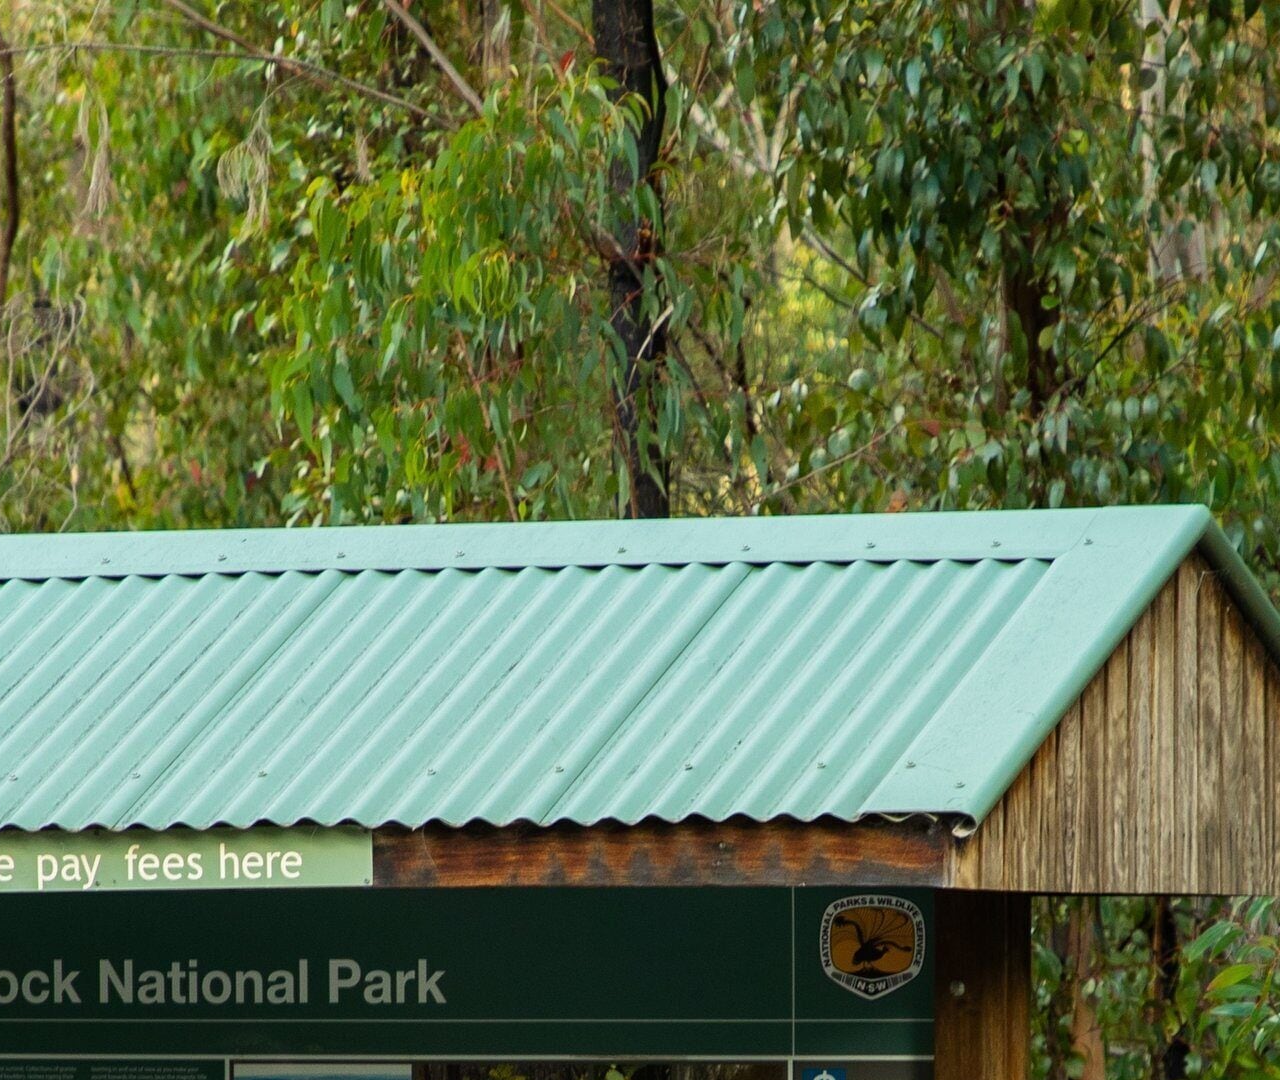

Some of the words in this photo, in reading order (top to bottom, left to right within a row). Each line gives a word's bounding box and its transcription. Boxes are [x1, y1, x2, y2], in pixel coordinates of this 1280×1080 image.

[37, 851, 99, 889] pay
[124, 845, 204, 881] fees
[219, 844, 303, 878] here
[822, 912, 834, 968] NATIONAL
[833, 897, 867, 910] PARKS
[878, 897, 919, 917] WILDLIFE
[913, 920, 924, 967] SERVICE
[99, 958, 308, 1004] National
[328, 958, 446, 1004] Park
